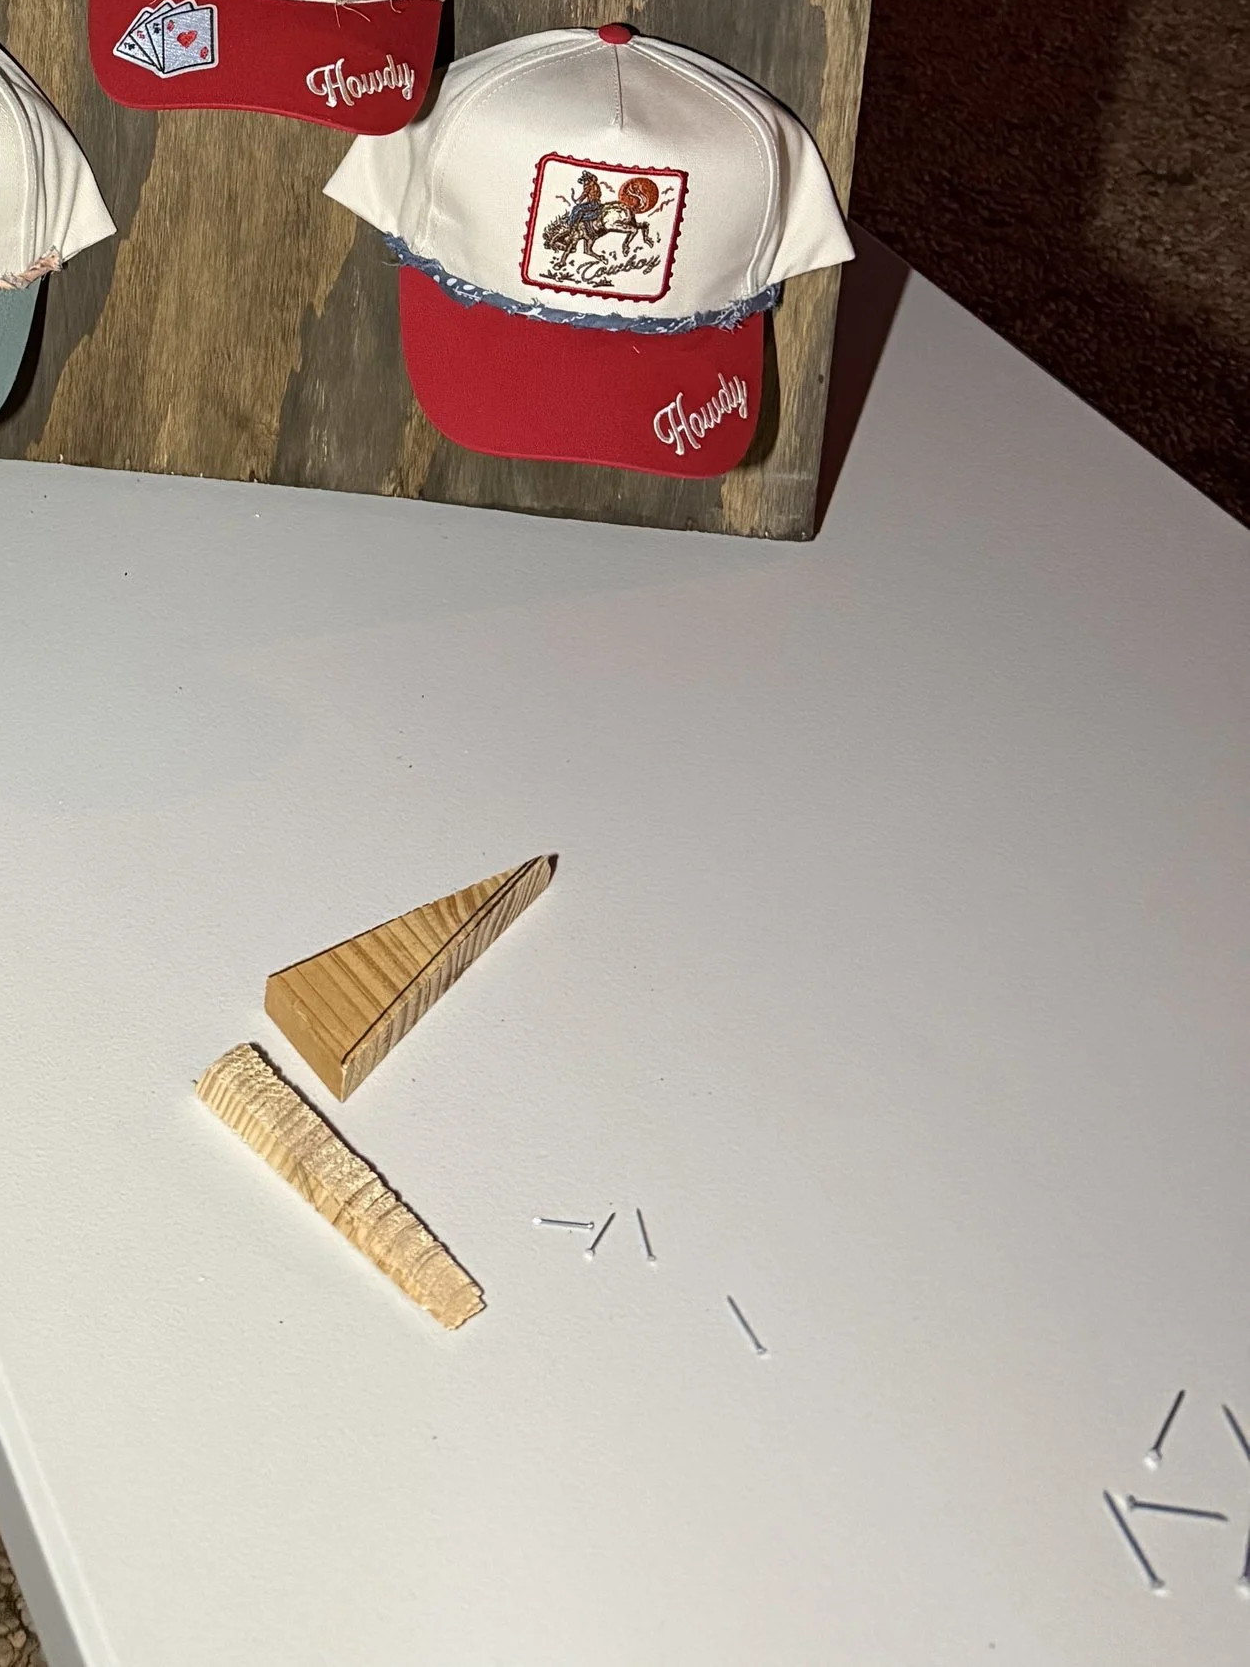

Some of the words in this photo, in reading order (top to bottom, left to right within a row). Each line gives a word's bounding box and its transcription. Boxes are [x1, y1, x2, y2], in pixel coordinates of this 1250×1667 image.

[306, 54, 416, 108] Howdy
[575, 254, 662, 283] Cowboy
[653, 373, 748, 456] Howdy
